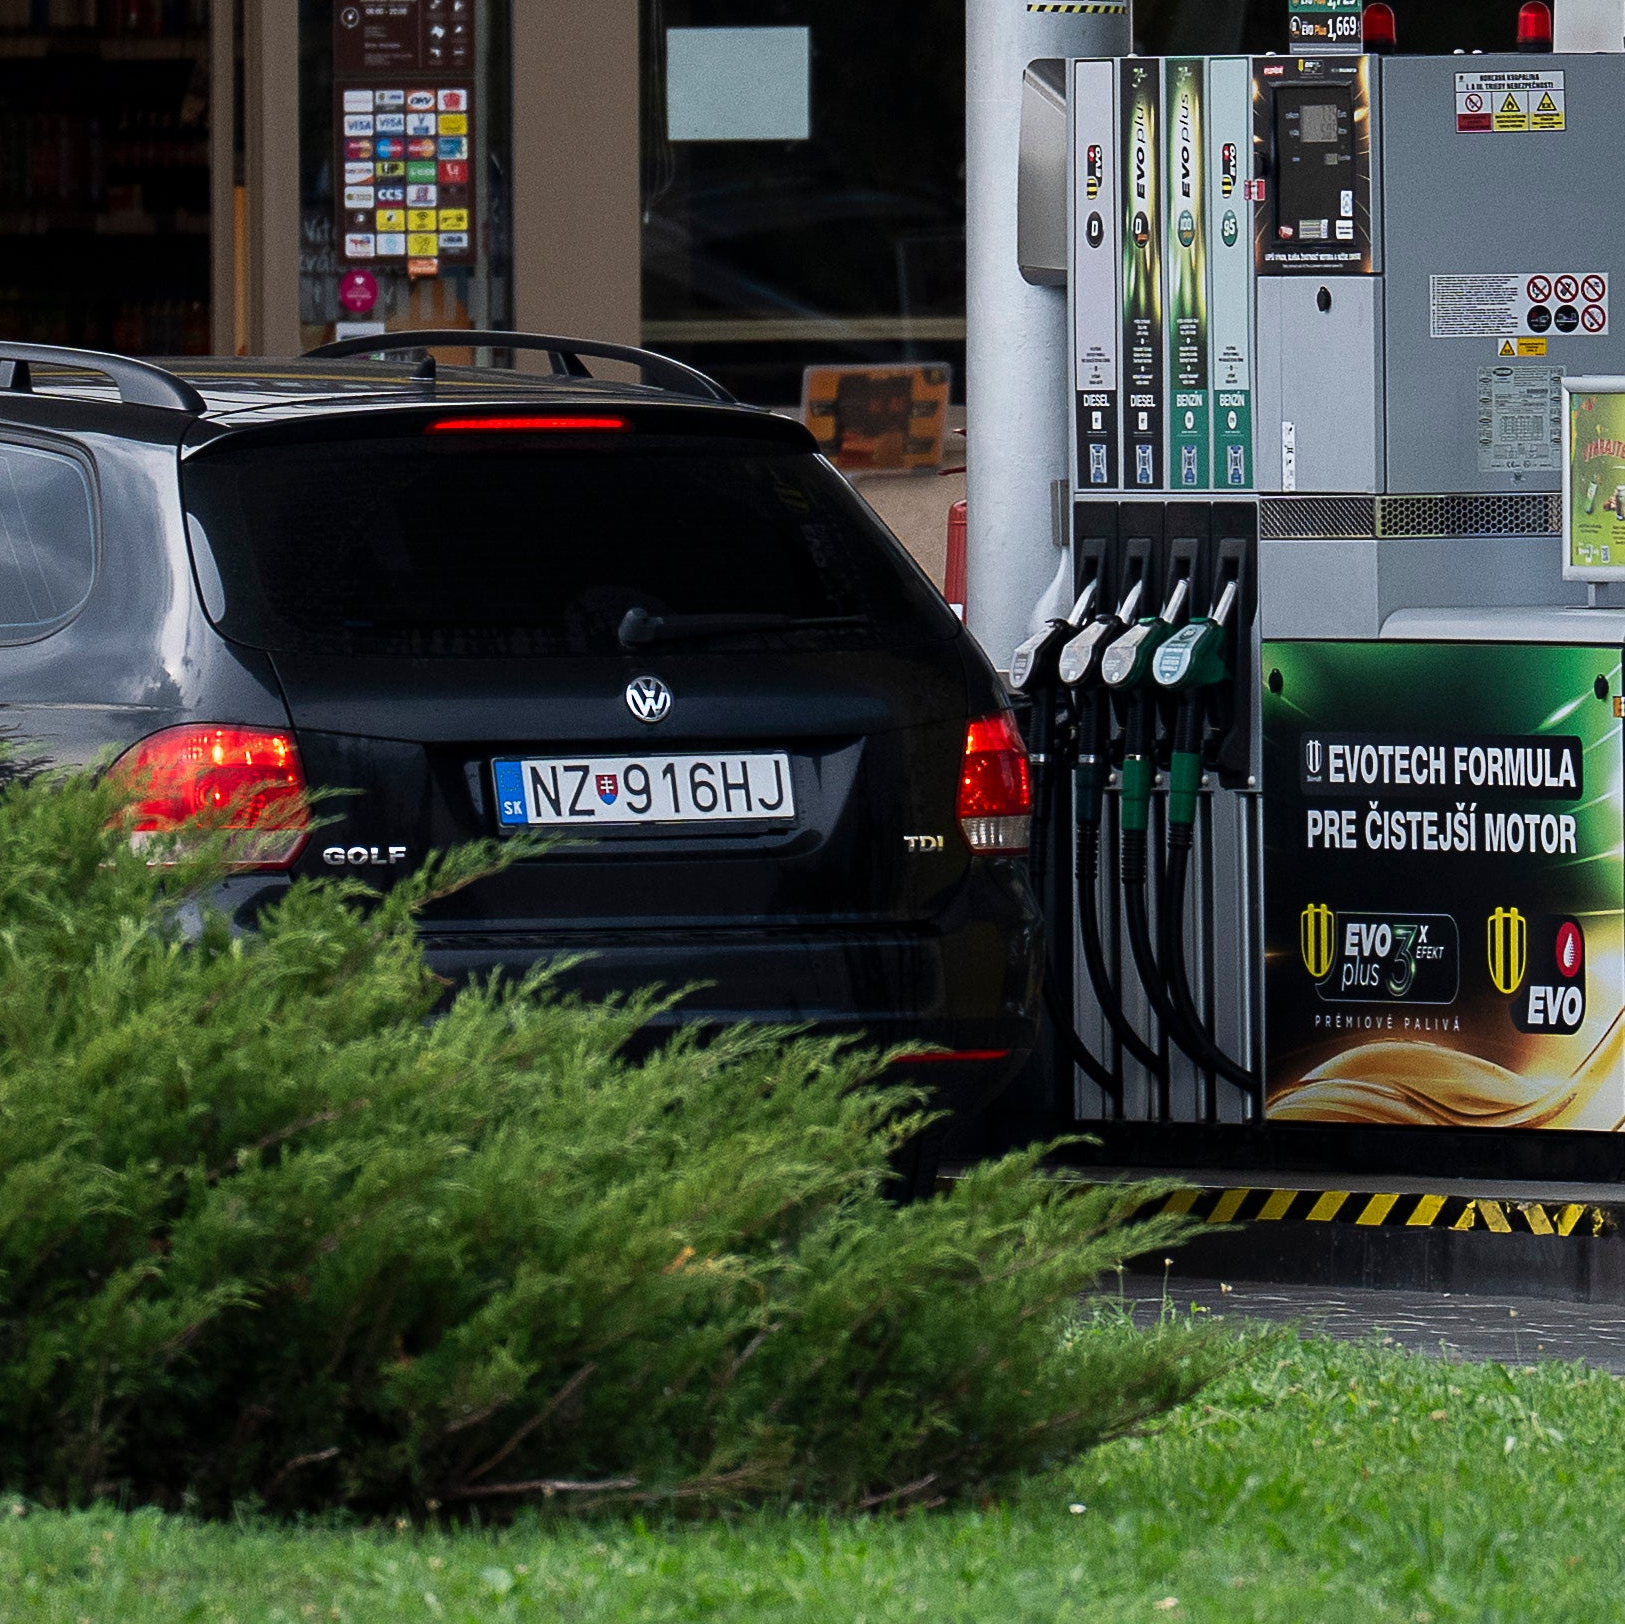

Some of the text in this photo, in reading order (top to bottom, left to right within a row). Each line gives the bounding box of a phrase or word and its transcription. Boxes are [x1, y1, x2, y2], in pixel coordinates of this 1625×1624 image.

[1327, 16, 1357, 41] 1,669
[1134, 92, 1147, 144] plus
[1178, 92, 1192, 144] plus
[1136, 146, 1146, 200] EVO
[1181, 145, 1191, 199] EVO
[377, 189, 405, 201] CCS
[1091, 220, 1099, 237] D
[1223, 220, 1236, 236] 95
[1083, 394, 1111, 407] DIESEL
[1130, 394, 1157, 407] DIESEL
[1176, 390, 1203, 407] BENZÍN
[1219, 390, 1246, 407] BENZÍN
[1328, 743, 1577, 788] EVOTECH FORMULA
[529, 759, 785, 818] NZ 916HJ
[503, 800, 523, 816] SK
[1306, 800, 1578, 854] PRE ČISTEJŠÍ MOTOR
[903, 835, 944, 852] TDI
[322, 845, 407, 866] GOLF
[1344, 922, 1393, 957] EVO
[1415, 945, 1445, 960] EFEKT
[1340, 954, 1380, 992] plus
[1526, 985, 1584, 1026] EVO
[1314, 1012, 1461, 1032] PRÉMIOVÉ PALIVÁ
